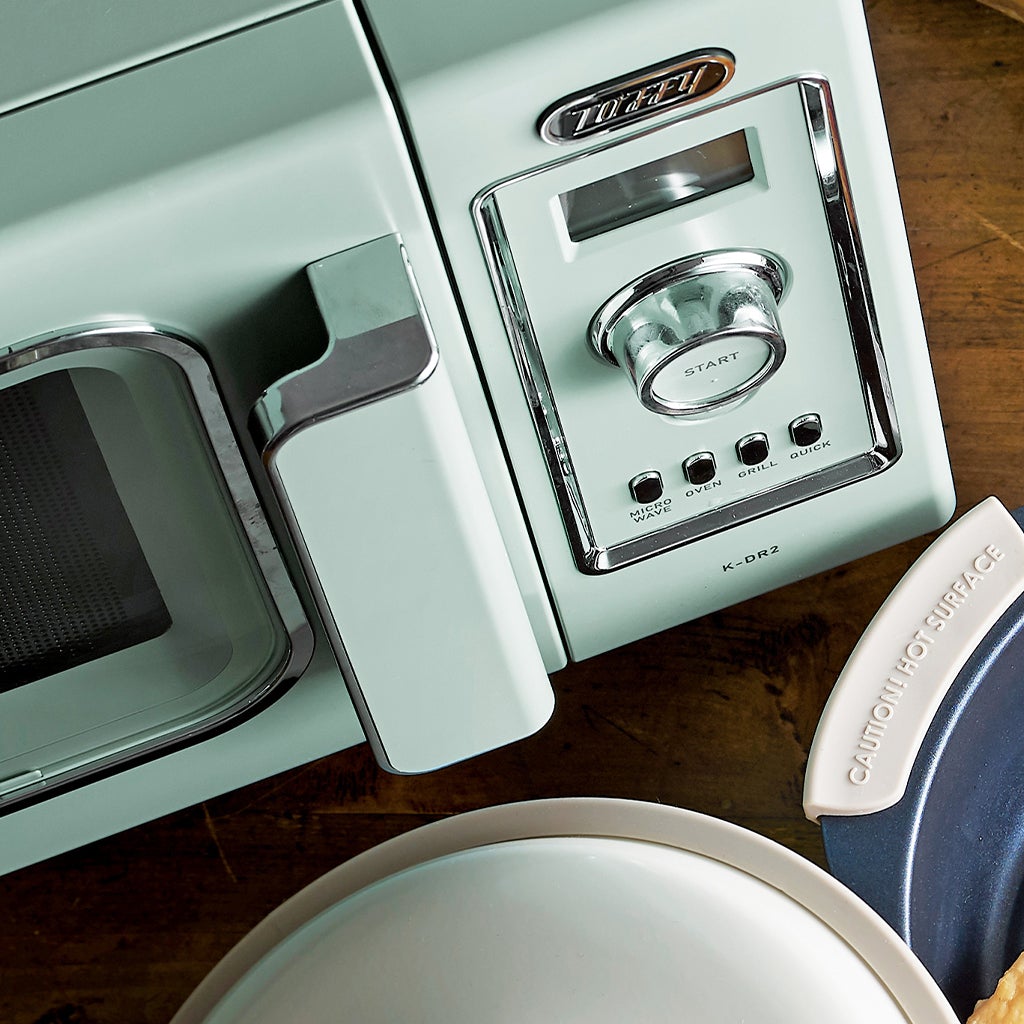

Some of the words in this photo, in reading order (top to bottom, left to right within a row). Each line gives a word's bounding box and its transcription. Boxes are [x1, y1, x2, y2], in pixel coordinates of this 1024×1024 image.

[684, 351, 739, 377] START
[790, 440, 832, 460] QUICK
[738, 461, 778, 478] GRILL
[685, 480, 722, 497] OVEN
[629, 498, 672, 519] MICRO
[633, 507, 672, 523] WAVE
[722, 545, 780, 572] K-DR2
[849, 677, 908, 785] CAUTION!
[896, 630, 936, 677] HOT
[925, 543, 1006, 632] SURFACE
